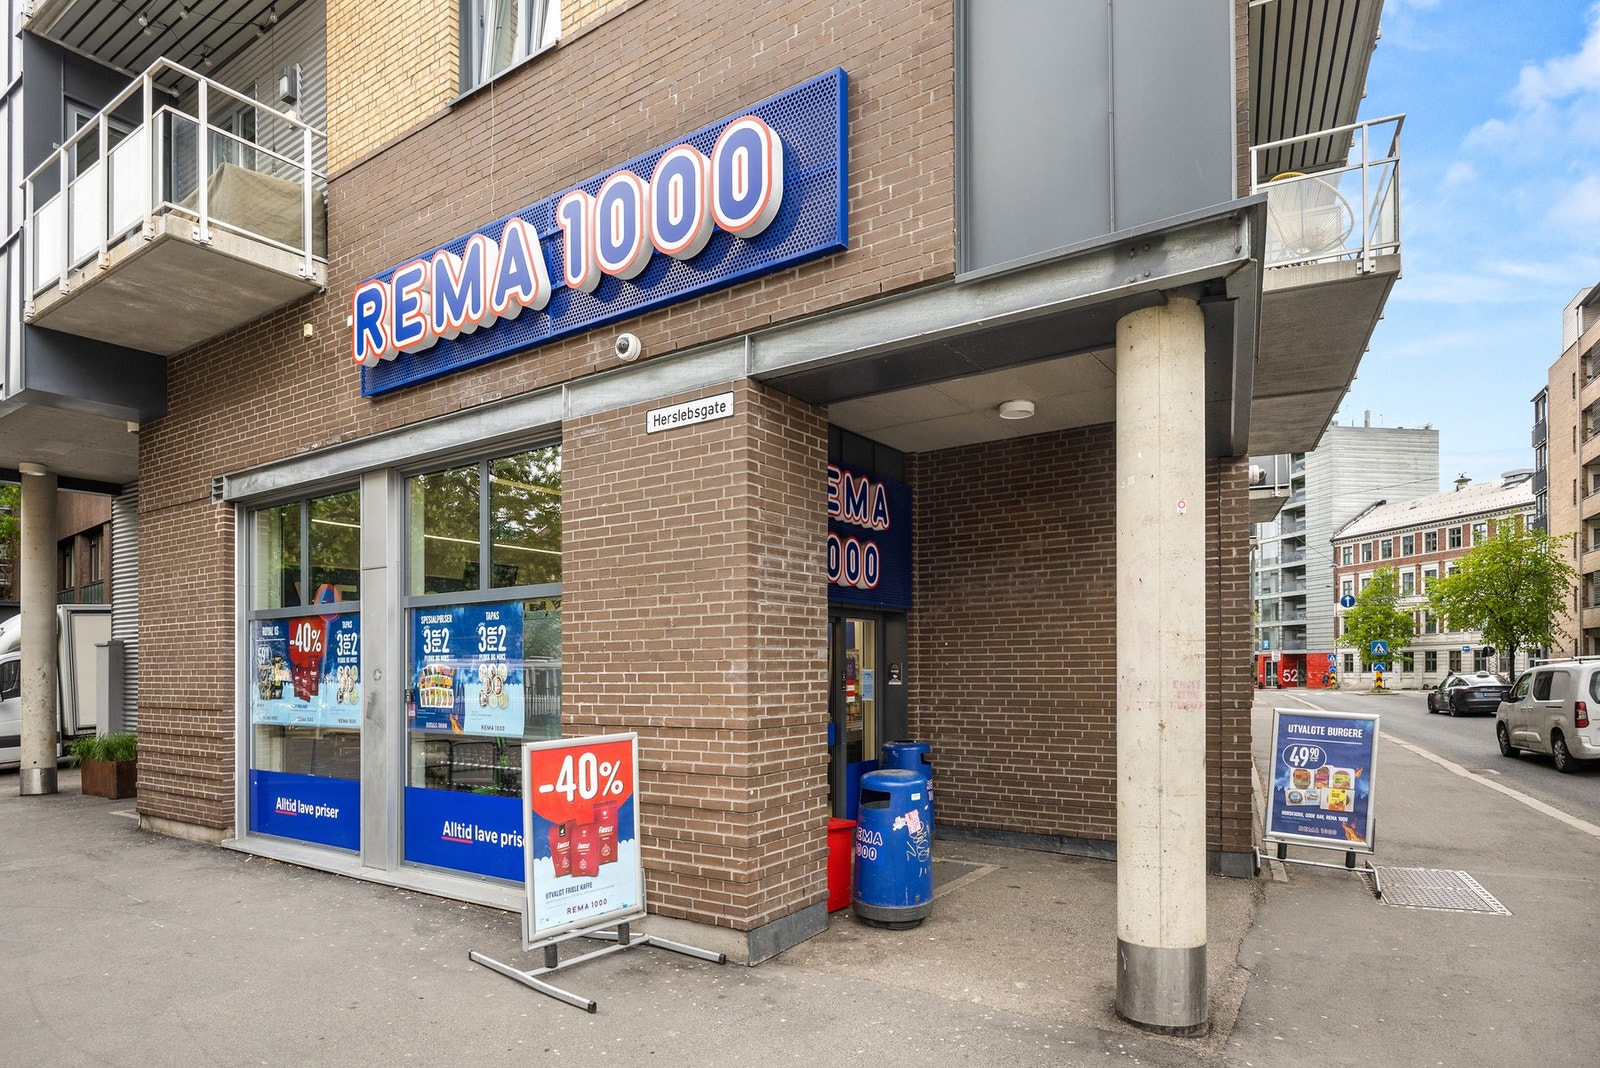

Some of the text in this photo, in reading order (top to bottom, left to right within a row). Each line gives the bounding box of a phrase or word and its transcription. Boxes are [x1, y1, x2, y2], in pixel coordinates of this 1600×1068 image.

[352, 115, 784, 368] REMA 1000
[653, 401, 727, 428] Herslebsgate
[828, 463, 890, 531] EMA
[828, 531, 880, 590] 000
[342, 620, 353, 629] TAPAS
[421, 614, 453, 624] SPESIALPØLSER
[485, 611, 500, 620] TAPAS
[289, 622, 322, 653] -40%
[336, 632, 358, 656] 3 FOR 2
[423, 627, 450, 654] 3 FOR 2
[478, 624, 507, 653] 3 FOR 2
[1287, 723, 1363, 738] UTVALGTE BURGERE
[1289, 746, 1310, 767] 49
[538, 752, 624, 803] -40%
[275, 796, 339, 820] Alltid lave priser
[442, 820, 525, 848] Alltid lave pris
[856, 826, 883, 846] EMA
[545, 888, 565, 900] UTVALGT
[565, 884, 579, 895] FRIELE
[580, 881, 593, 891] KAFFE
[566, 898, 607, 915] REMA 1000
